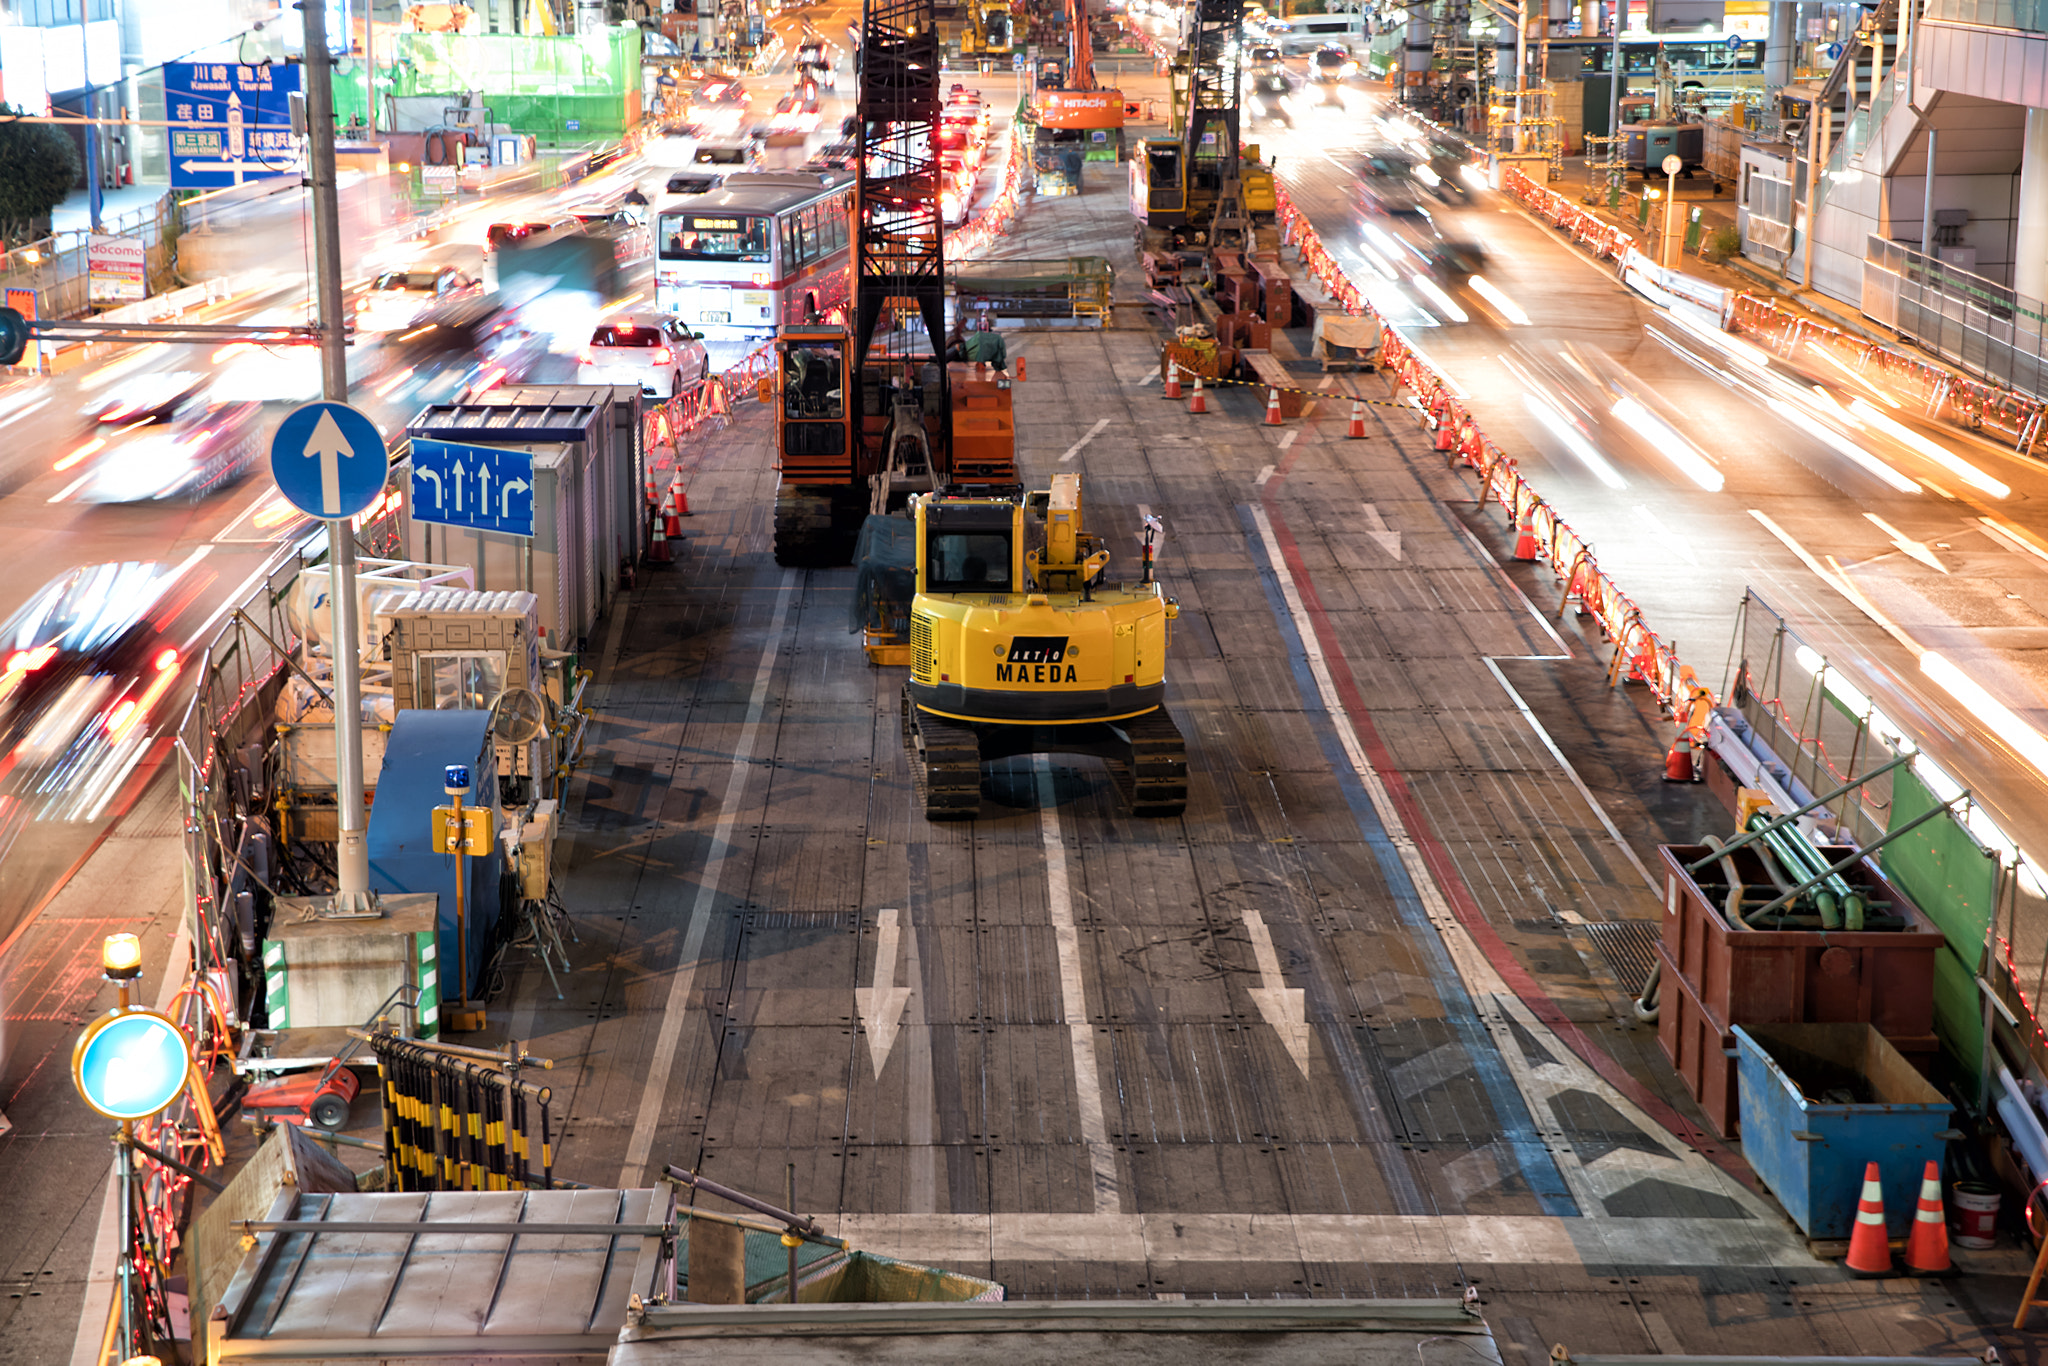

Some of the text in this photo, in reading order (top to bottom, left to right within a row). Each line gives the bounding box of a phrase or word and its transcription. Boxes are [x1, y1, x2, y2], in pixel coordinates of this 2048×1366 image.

[190, 81, 273, 91] Kawasaki Tsurumi
[1063, 99, 1107, 108] HITACHI
[90, 242, 143, 256] docomo
[1012, 647, 1060, 664] AKTIO
[996, 663, 1078, 683] MAEDA
